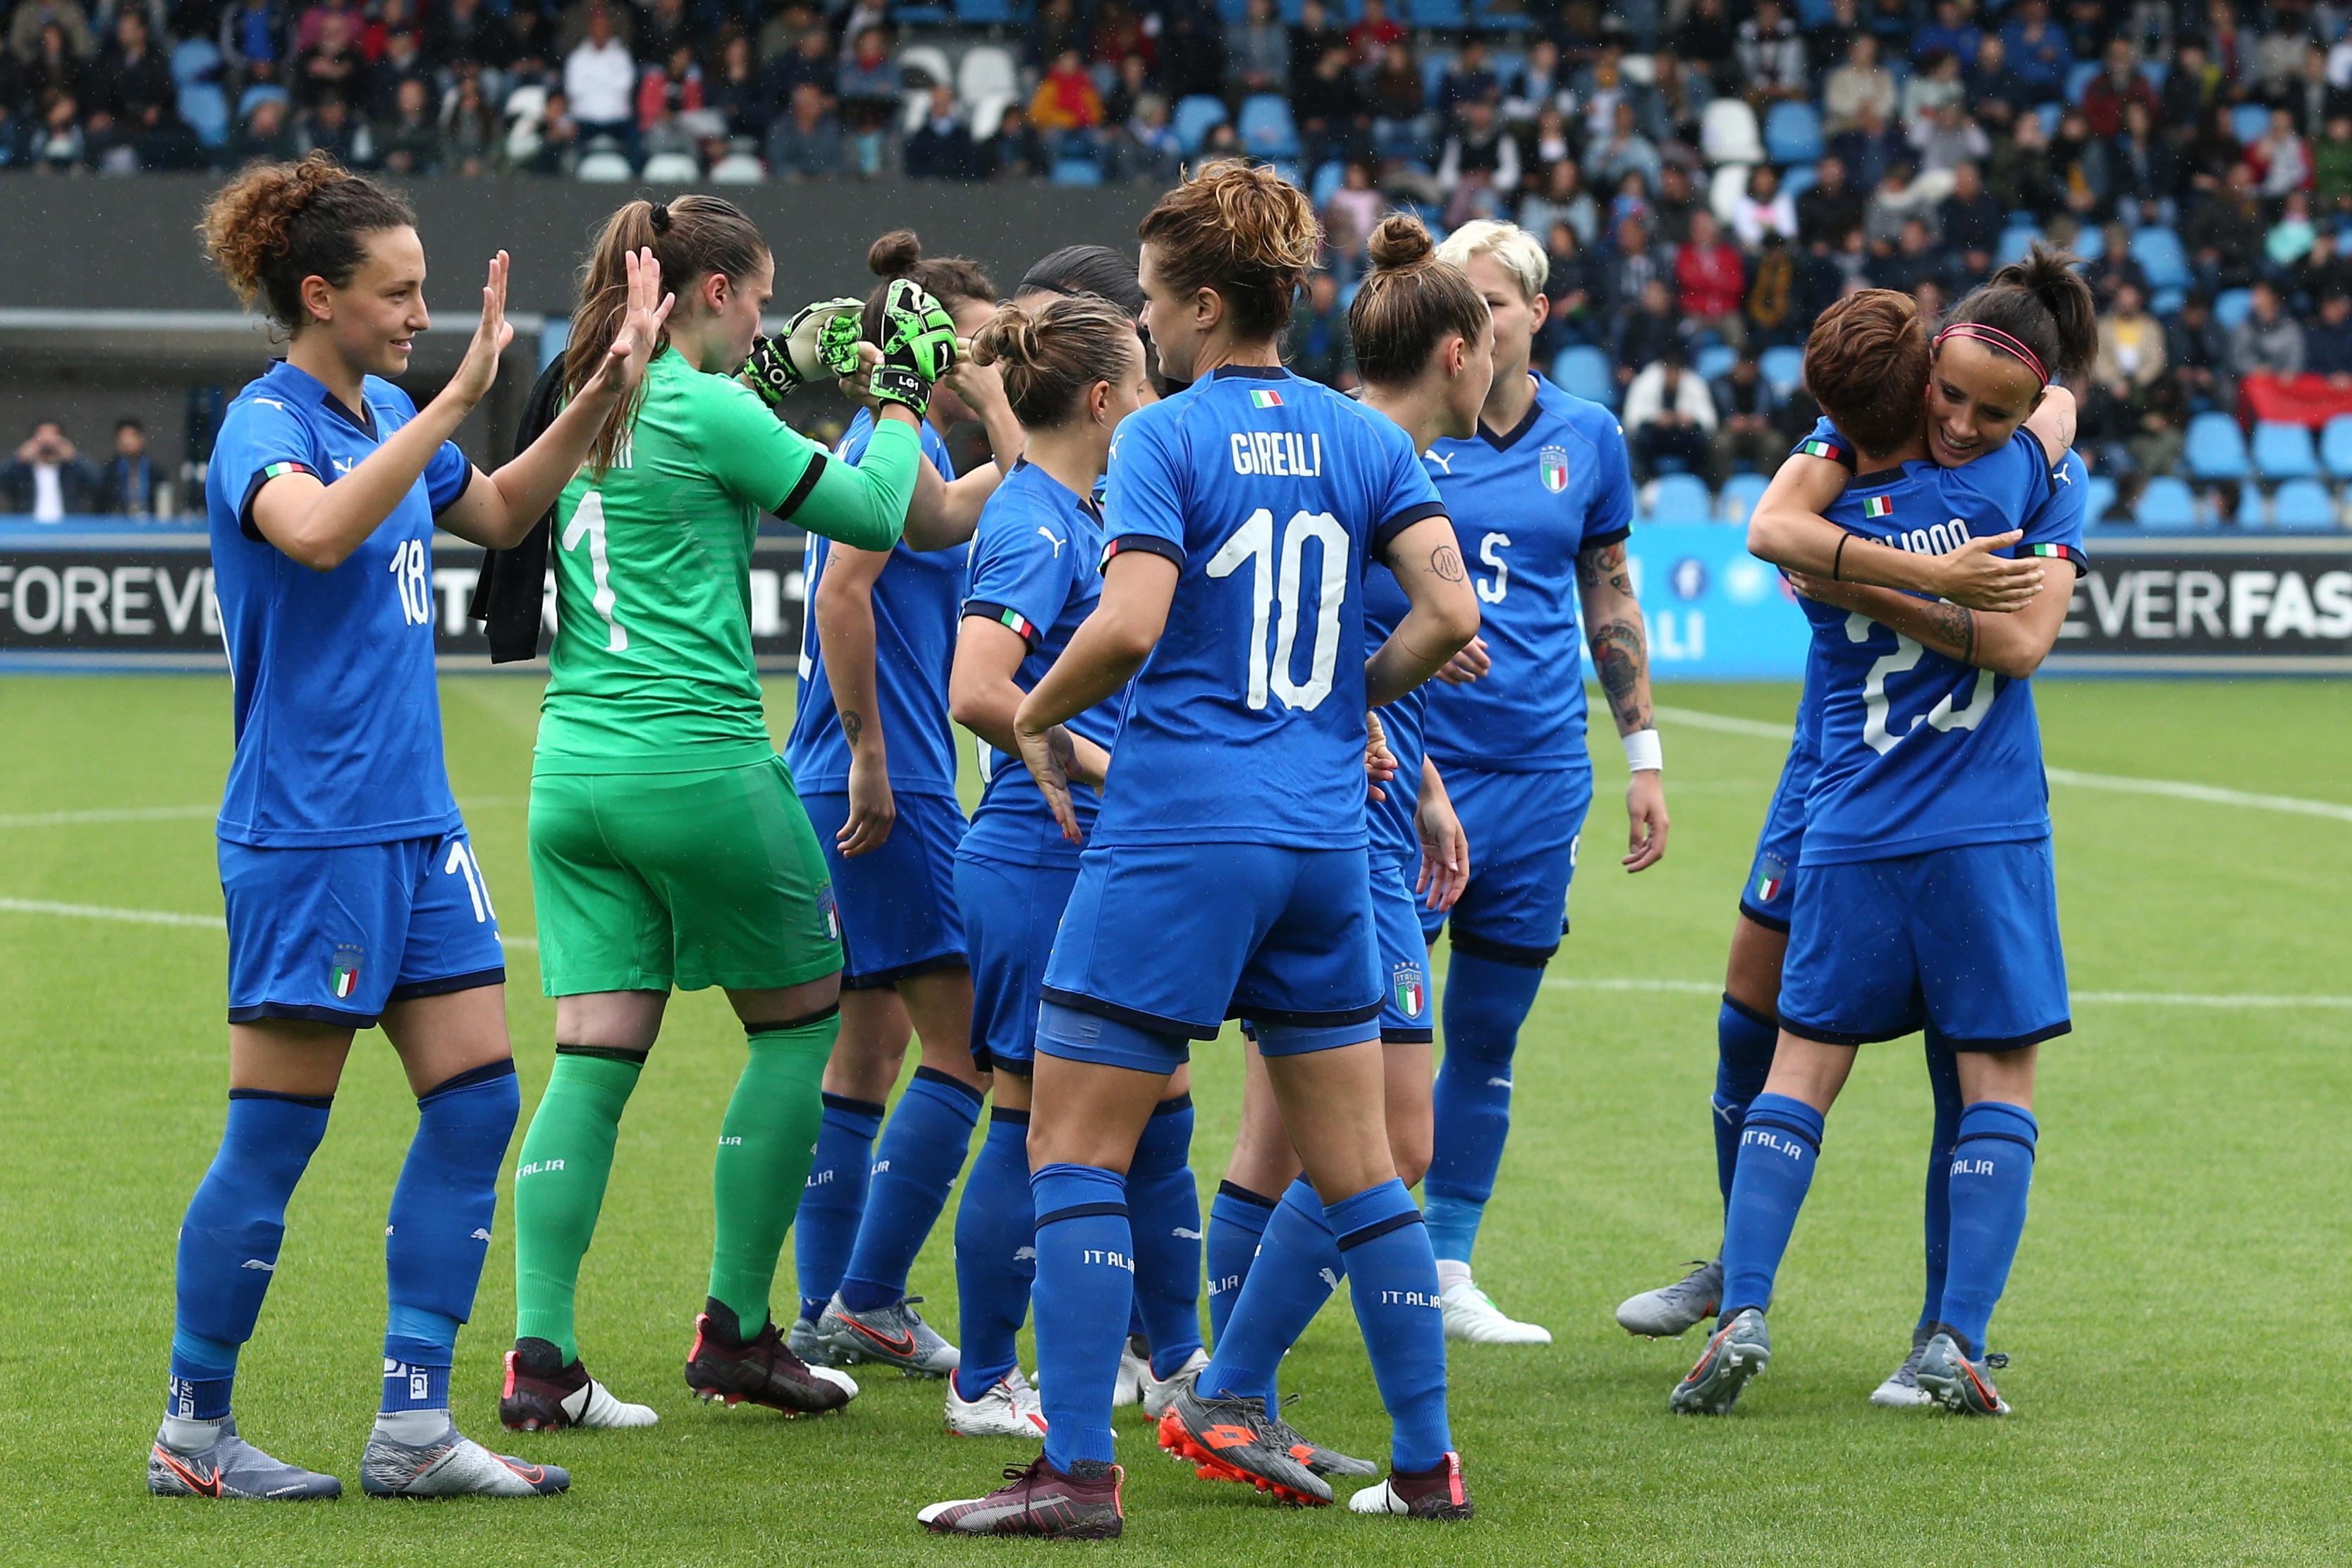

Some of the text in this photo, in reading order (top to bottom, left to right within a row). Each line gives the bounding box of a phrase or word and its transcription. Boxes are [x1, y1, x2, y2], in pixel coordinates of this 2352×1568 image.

[899, 376, 919, 391] LG1
[1230, 431, 1321, 477] GIRELLI
[564, 491, 627, 651] 1
[1477, 532, 1512, 604] 5
[389, 539, 429, 625] 18
[1206, 508, 1349, 711] 10
[1397, 974, 1421, 982] ITALIA
[1741, 1130, 1802, 1160] ITALIA
[515, 1159, 565, 1181] TALIA
[1949, 1159, 1995, 1176] TALIA
[1084, 1250, 1135, 1275] ITALIA
[1382, 1291, 1441, 1309] ITALIA
